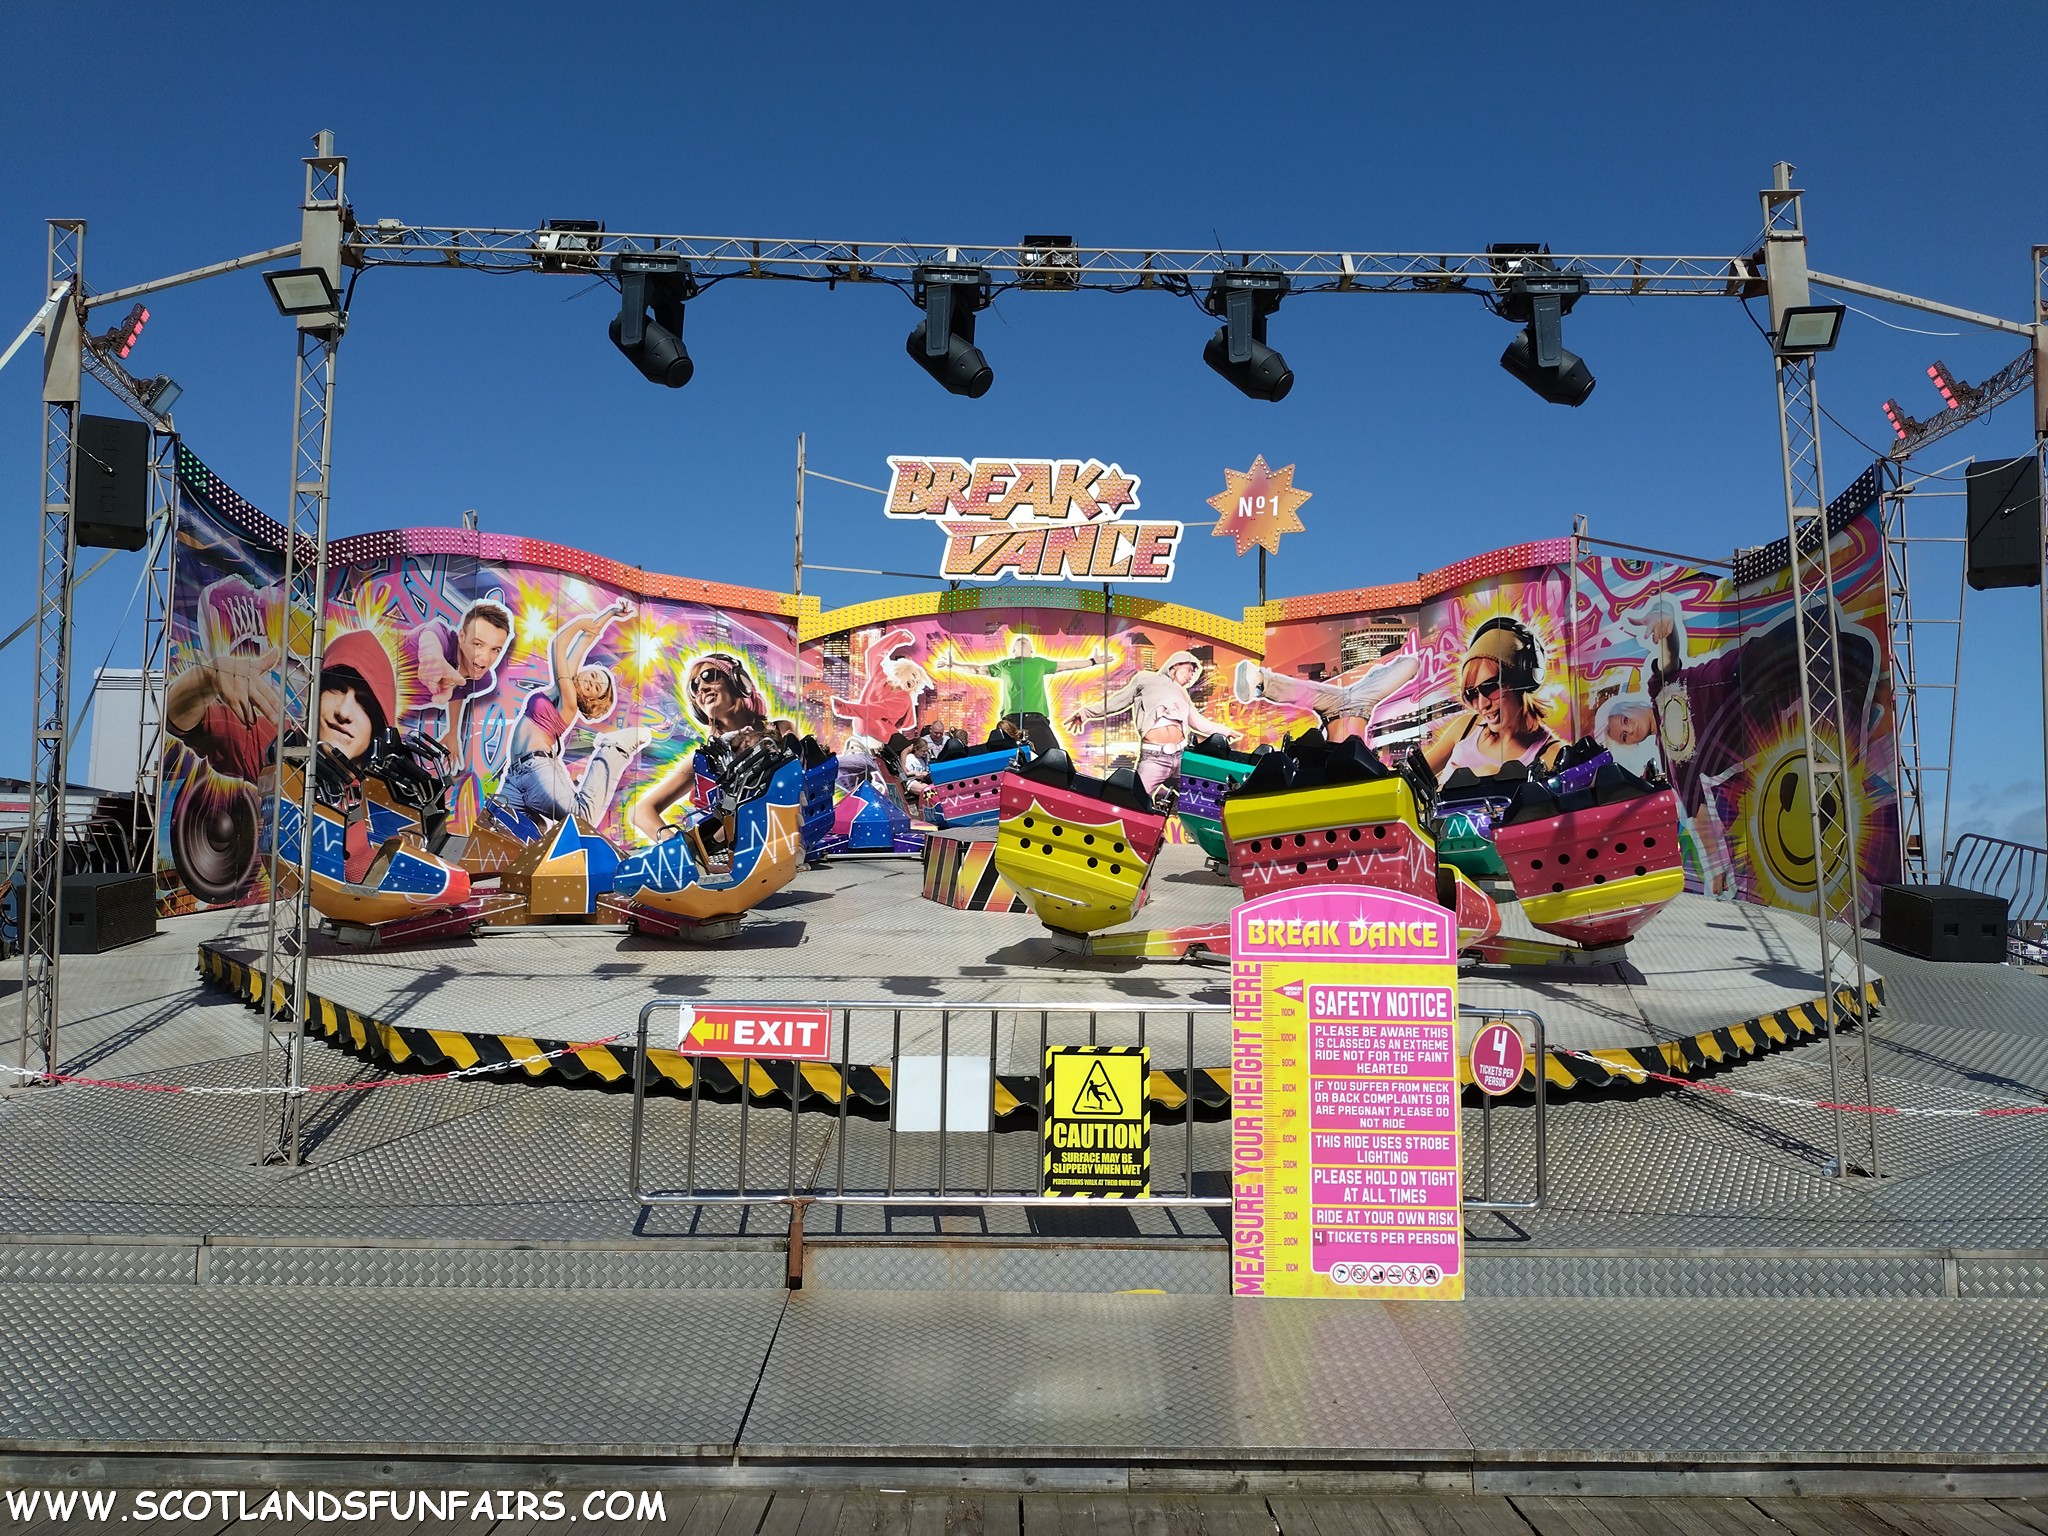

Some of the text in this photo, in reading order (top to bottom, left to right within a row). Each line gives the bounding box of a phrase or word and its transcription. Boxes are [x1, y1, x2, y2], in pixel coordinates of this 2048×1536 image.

[891, 460, 1106, 519] BREAK
[942, 520, 1179, 577] DANCE
[1248, 918, 1439, 949] BREAK DANCE
[1315, 990, 1447, 1018] SAFETY NOTICE
[733, 1020, 819, 1047] EXIT
[1315, 1025, 1449, 1038] PLEASE BE AWARE THIS
[1315, 1038, 1449, 1051] IS CLASSED AS AN EXTREME
[1493, 1029, 1508, 1066] 4
[1315, 1050, 1449, 1062] RIDE NOT FOR THE FAINT
[1357, 1063, 1408, 1074] HEARTED
[1479, 1064, 1515, 1079] TICKETS PER
[1315, 1081, 1449, 1093] IF YOU SUFFER FROM NECK
[1484, 1075, 1507, 1088] PERSON
[1314, 1093, 1450, 1105] OR BACK COMPLAINTS OR
[1315, 1105, 1449, 1117] ARE PREGNANT PLEASE DO
[1233, 963, 1264, 1295] MEASURE YOUR HEIGHT HERE
[1360, 1118, 1405, 1129] NOT RIDE
[1053, 1122, 1142, 1149] CAUTION
[1315, 1135, 1450, 1150] THIS RIDE USES STROBE
[1061, 1152, 1133, 1164] SURFACE MAY BE
[1357, 1151, 1409, 1164] LIGHTING
[1052, 1163, 1142, 1175] SLIPPERY WHEN WET
[1052, 1178, 1084, 1186] PEDESTRIANS
[1084, 1178, 1097, 1186] WALK
[1104, 1179, 1118, 1187] THEIR
[1118, 1179, 1130, 1187] OWN
[1130, 1179, 1143, 1187] RISK
[1314, 1169, 1455, 1186] PLEASE HOLD ON TIGHT
[1343, 1187, 1427, 1204] AT ALL TIMES
[1316, 1210, 1454, 1226] RIDE AT YOUR OWN RISK
[1314, 1230, 1456, 1245] 4 TICKETS PER PERSON
